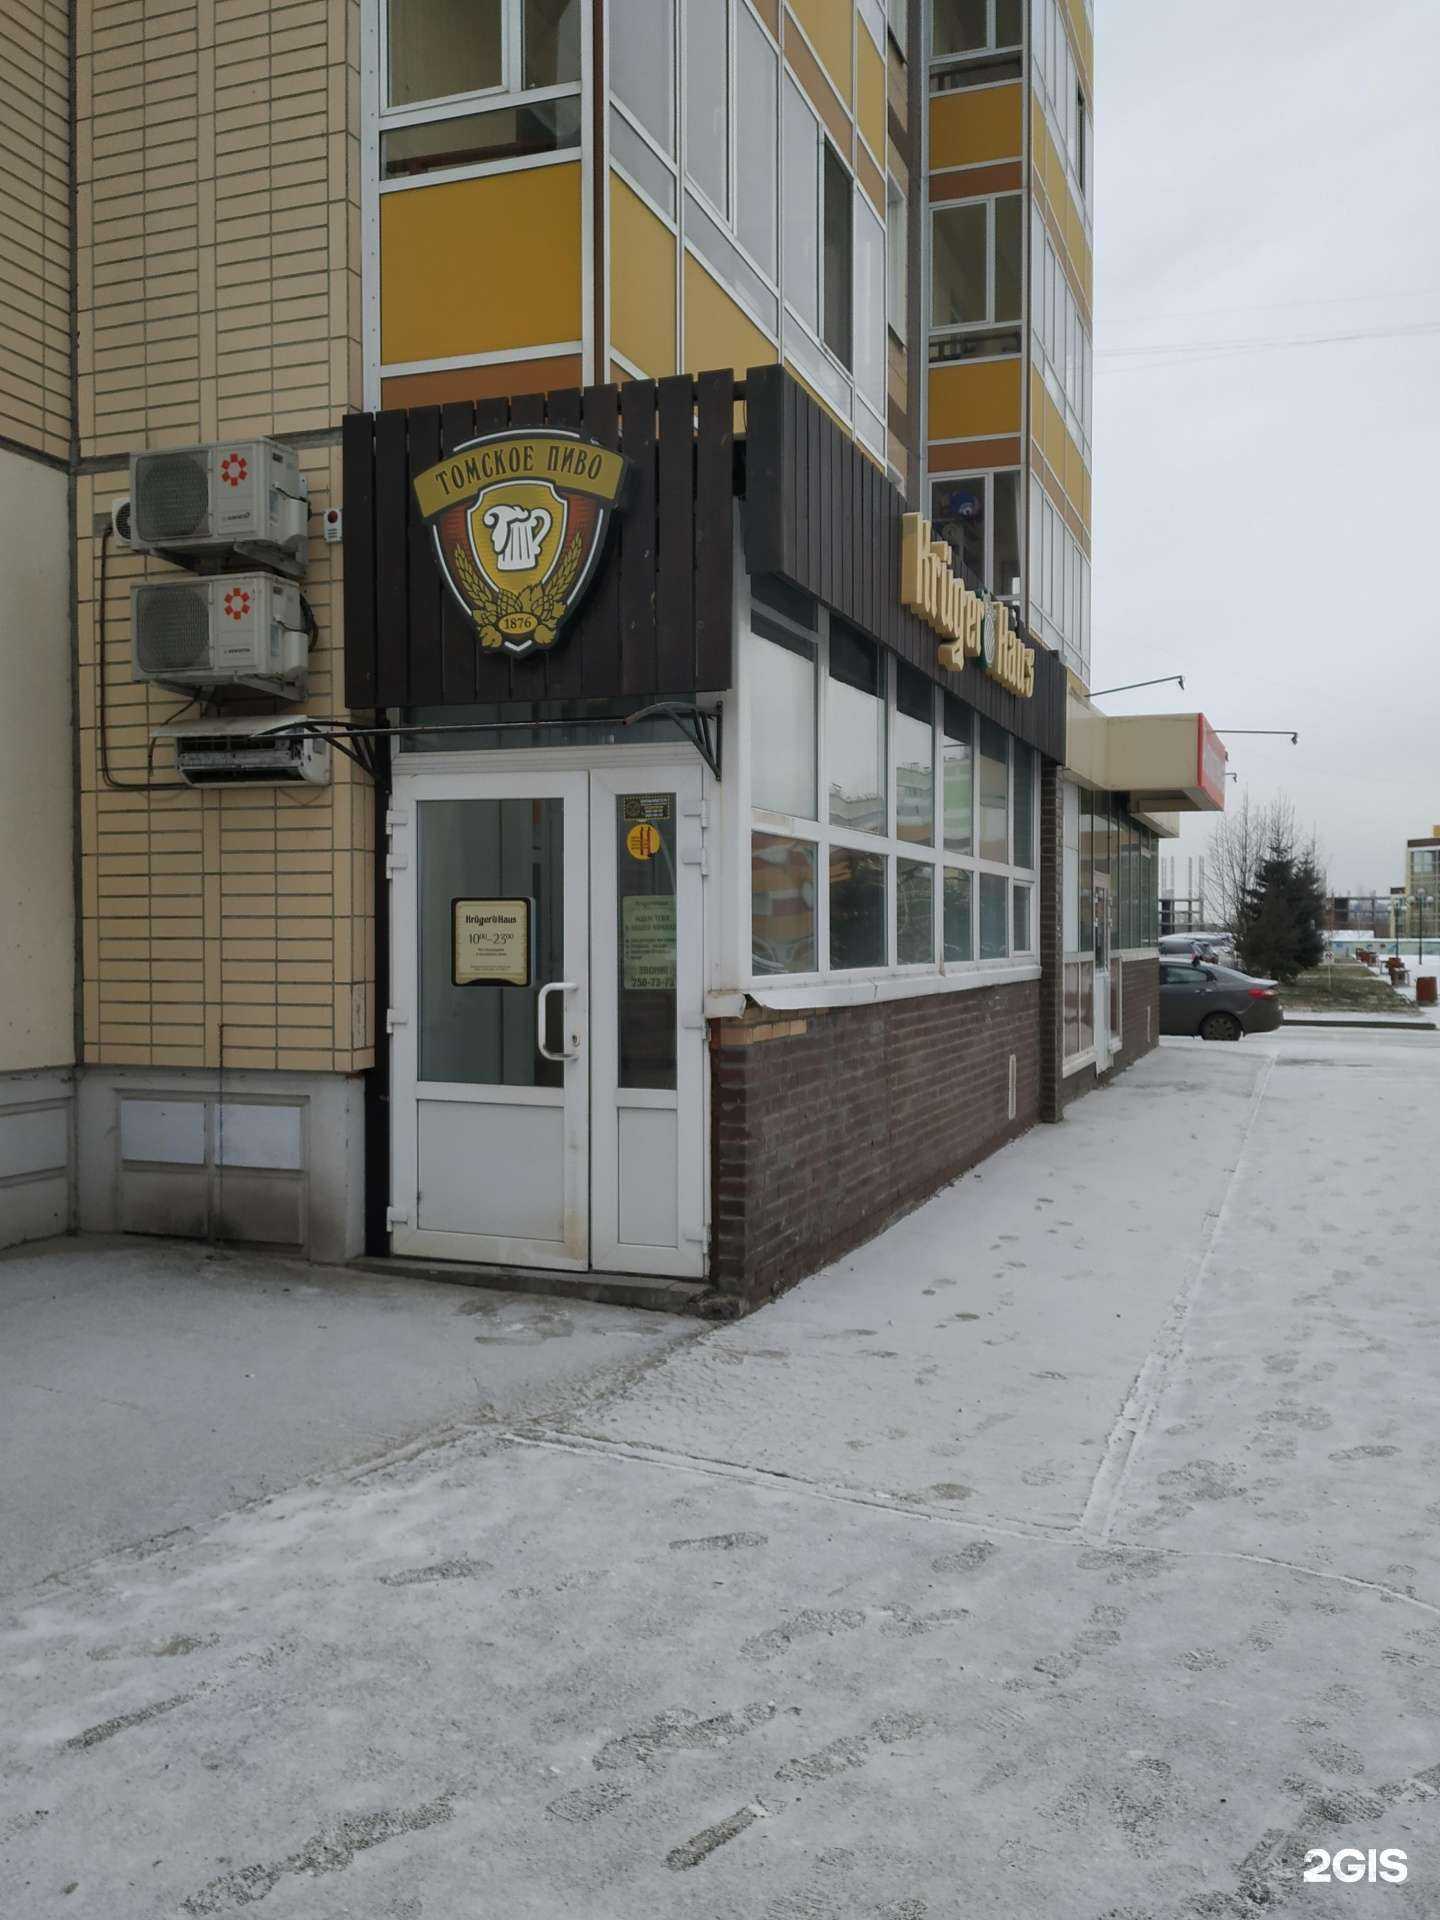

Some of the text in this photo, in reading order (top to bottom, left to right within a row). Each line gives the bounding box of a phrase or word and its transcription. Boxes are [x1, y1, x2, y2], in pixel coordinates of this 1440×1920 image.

[436, 445, 602, 495] ТОМСКОЕ ПИВО
[504, 616, 532, 629] 1876
[989, 601, 1035, 698] Haus
[498, 914, 517, 923] Haus
